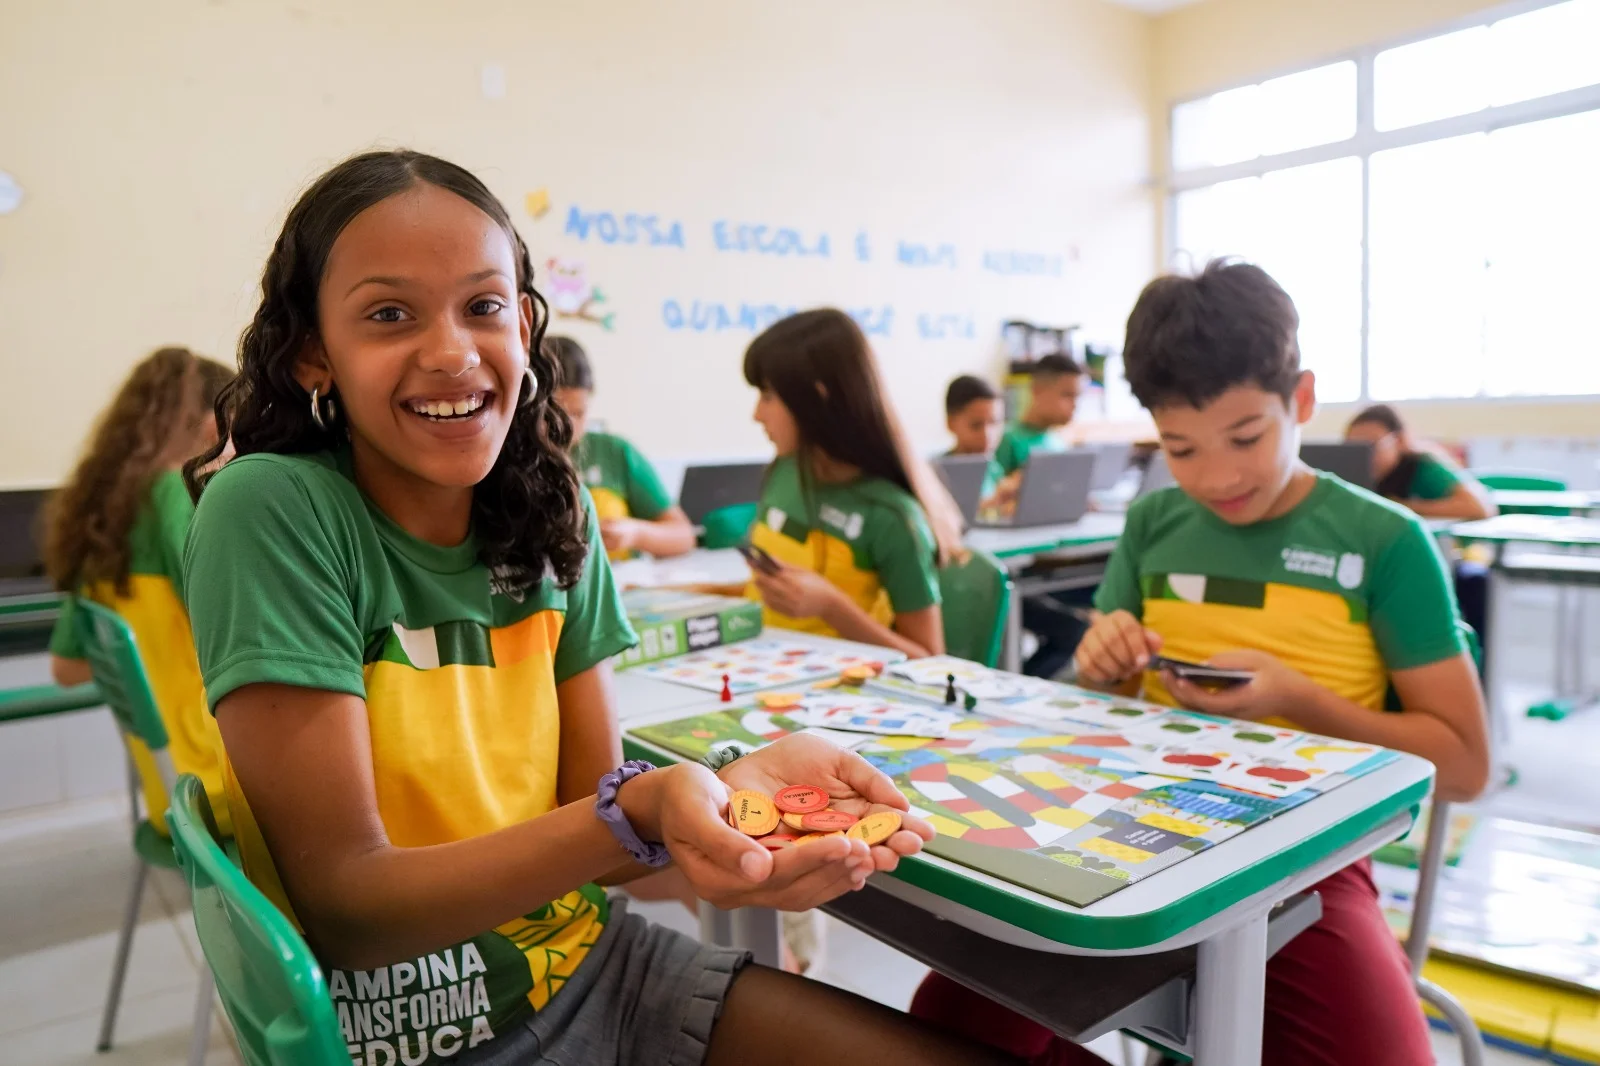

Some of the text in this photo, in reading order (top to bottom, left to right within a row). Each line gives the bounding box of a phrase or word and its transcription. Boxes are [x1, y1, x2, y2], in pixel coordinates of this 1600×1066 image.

[563, 203, 687, 250] NOSSA
[712, 218, 834, 260] ESCOLA
[330, 942, 487, 1000] AMPINA
[338, 976, 491, 1043] ANSFORMA
